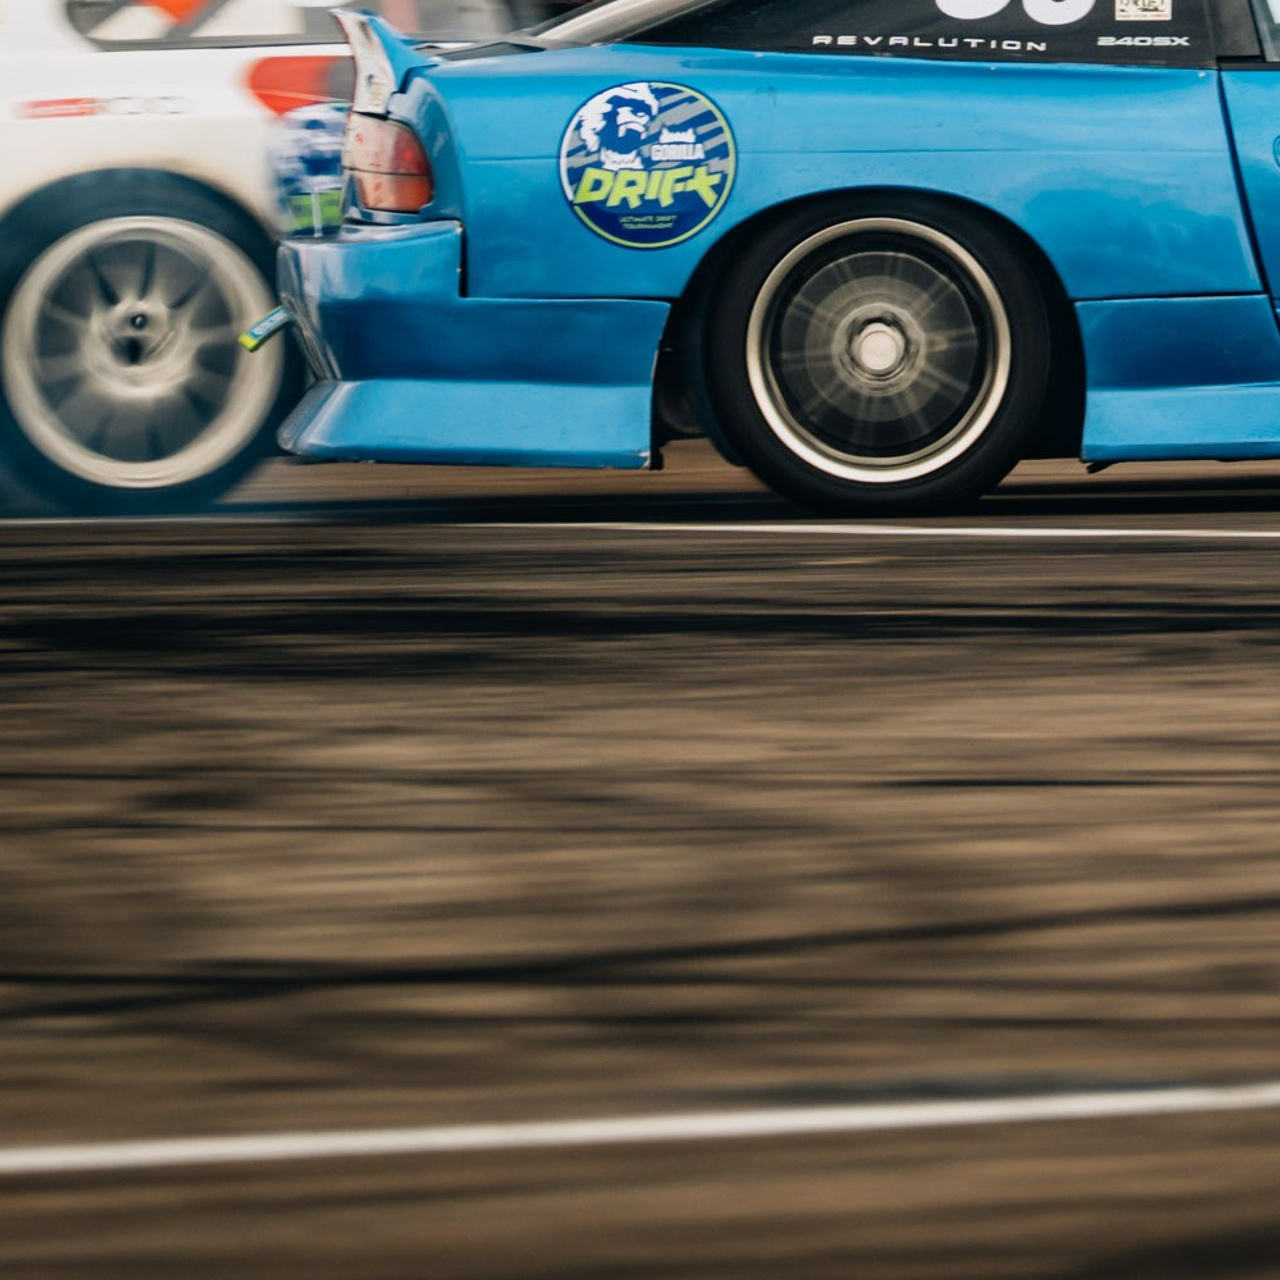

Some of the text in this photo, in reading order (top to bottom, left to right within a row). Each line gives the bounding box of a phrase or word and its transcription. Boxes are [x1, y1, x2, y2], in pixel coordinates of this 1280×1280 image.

[812, 35, 1190, 52] REVALUTION 240SX
[572, 166, 722, 209] DRIFT
